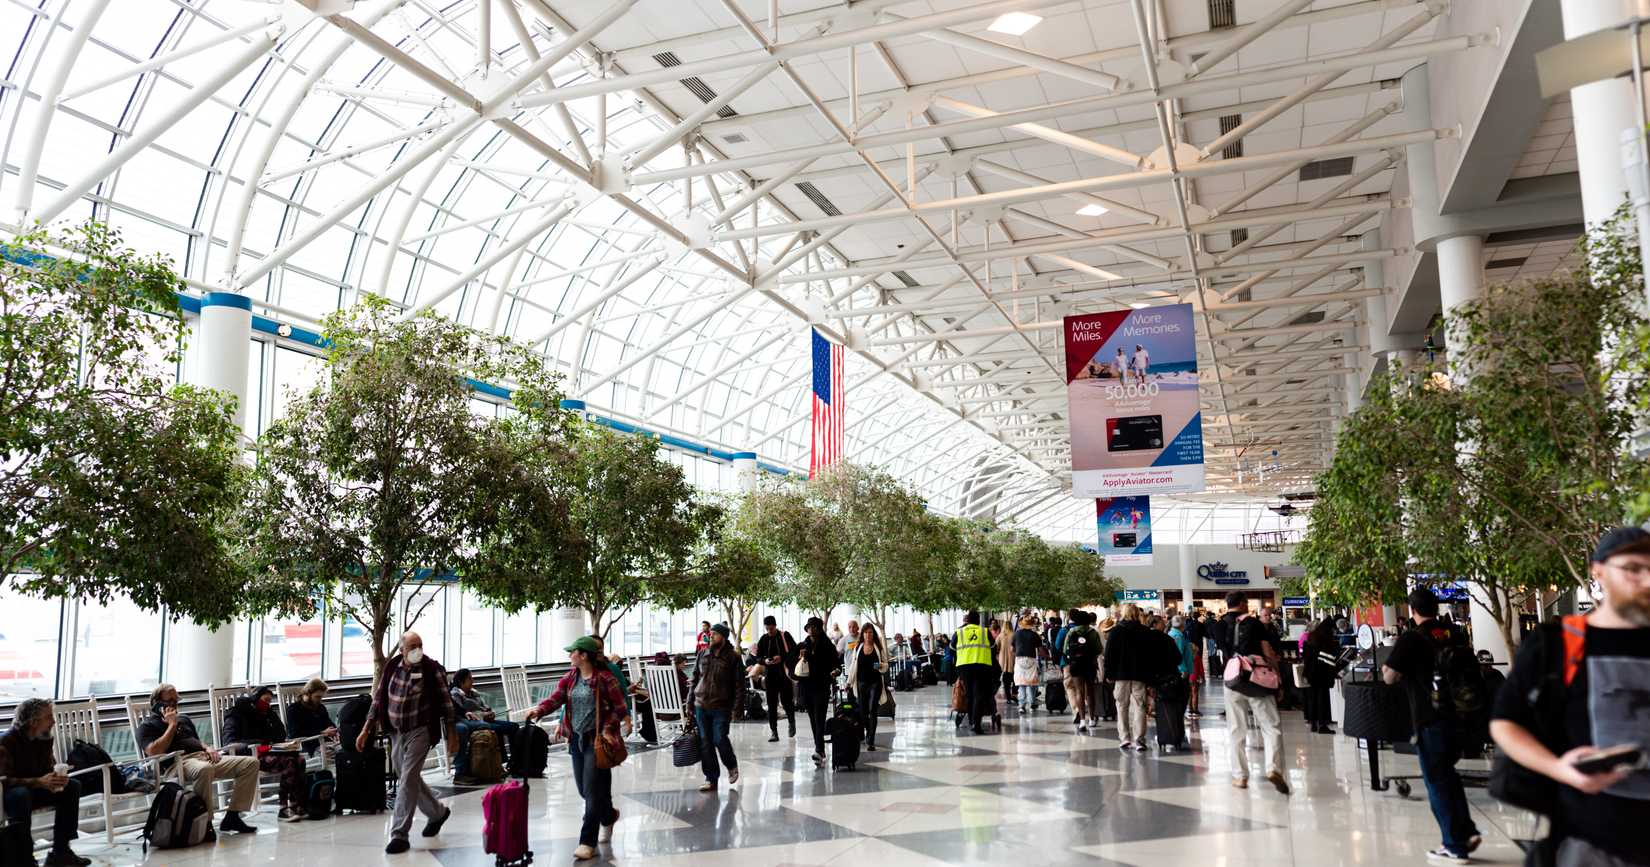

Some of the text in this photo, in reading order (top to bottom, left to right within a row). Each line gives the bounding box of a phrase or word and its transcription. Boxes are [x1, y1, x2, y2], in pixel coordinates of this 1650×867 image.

[1132, 314, 1161, 325] More
[1072, 321, 1101, 332] More
[1072, 332, 1103, 342] Miles.
[1105, 382, 1159, 400] 50,000
[1103, 476, 1173, 487] ApplyAviator.com
[1230, 570, 1248, 578] CITY
